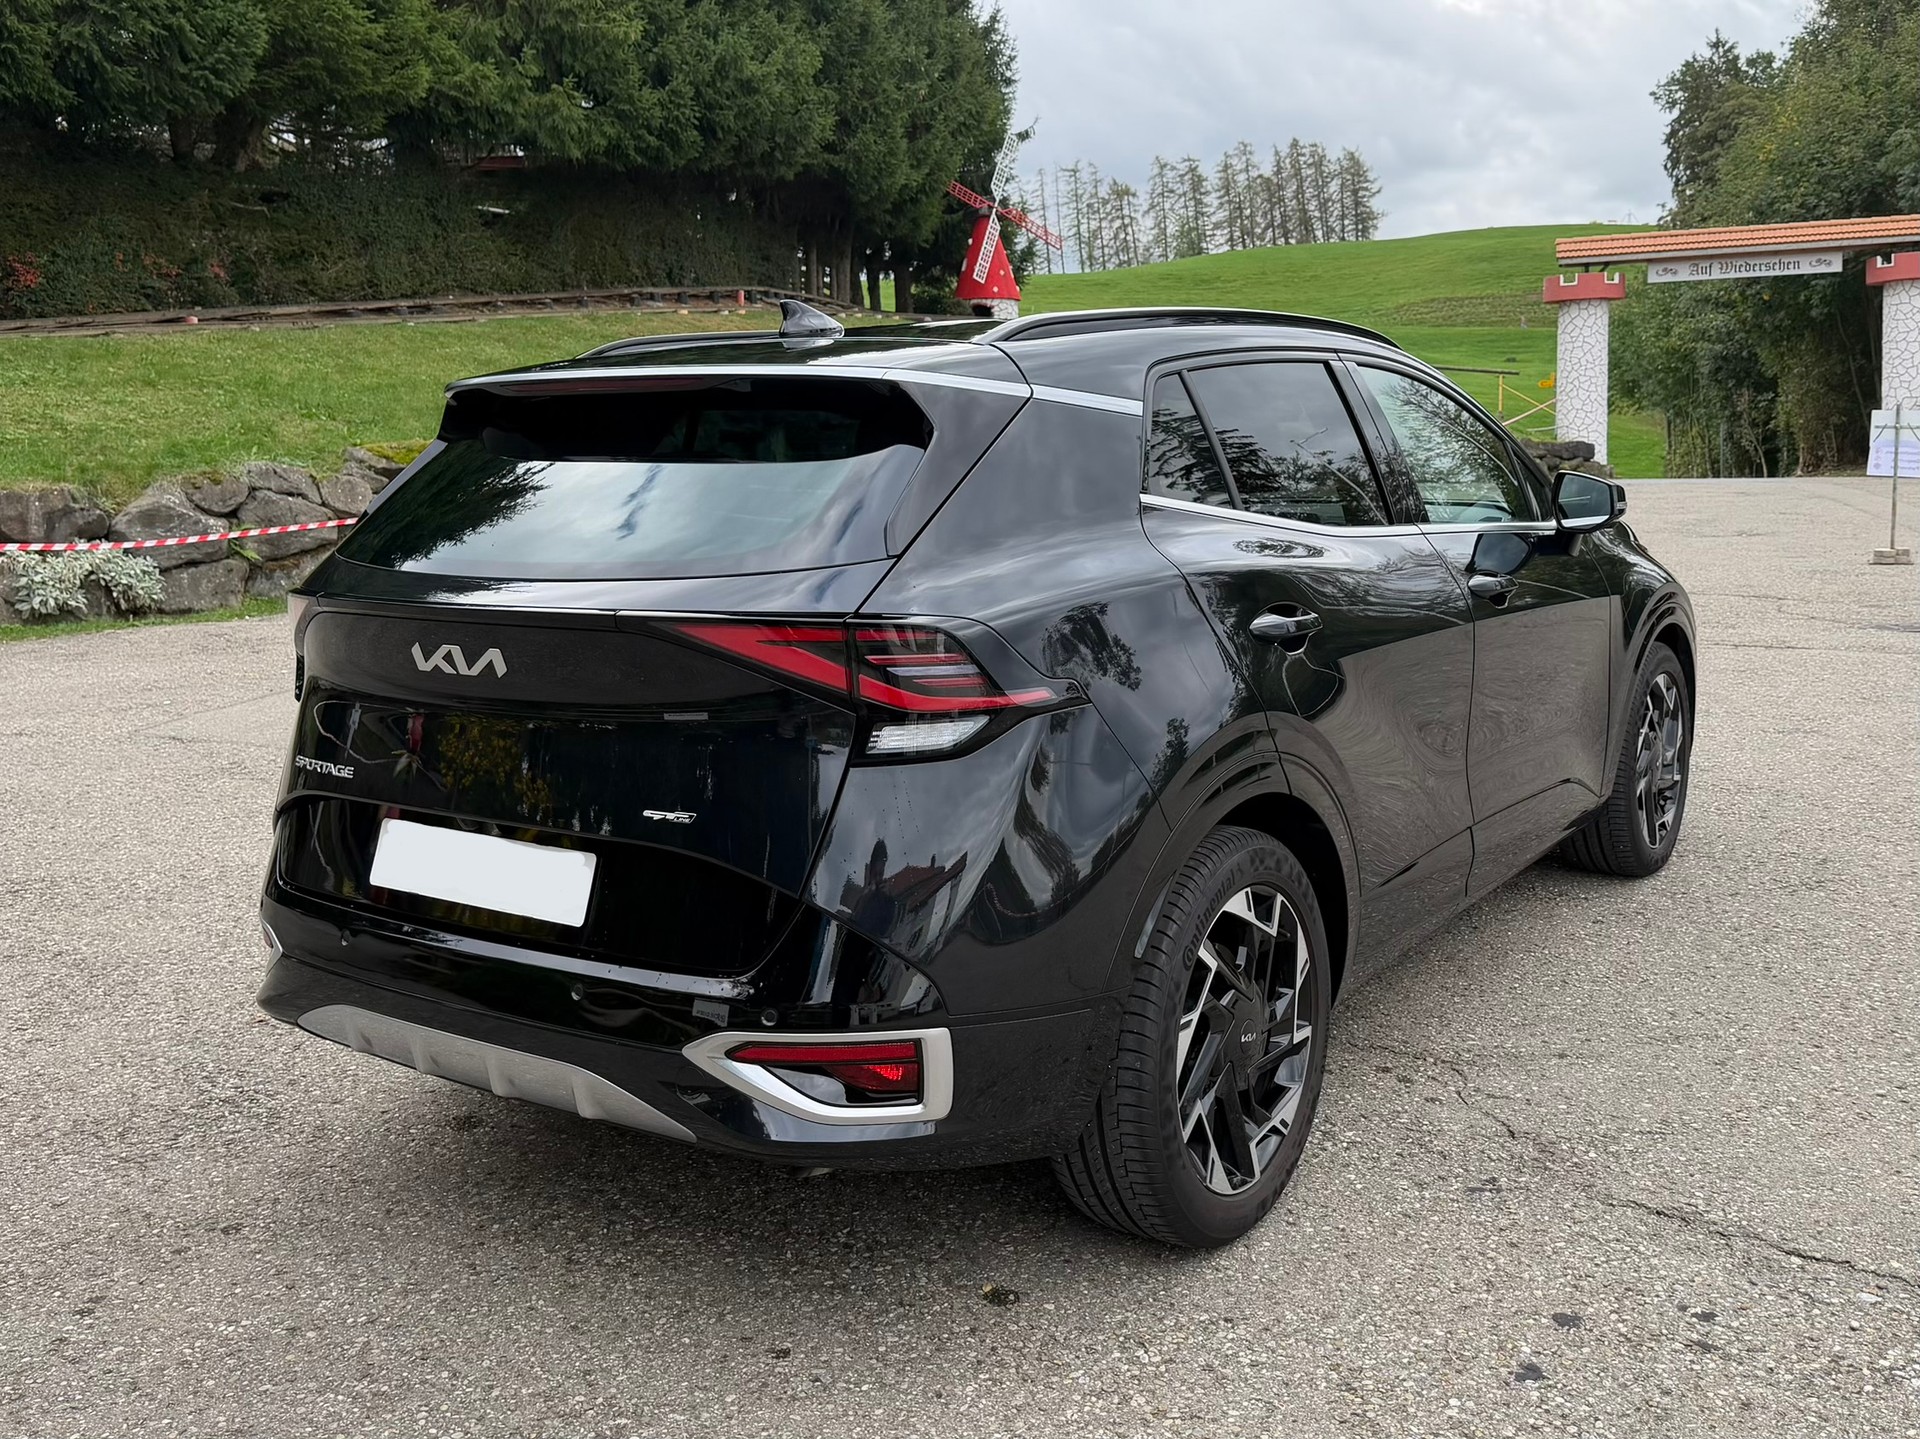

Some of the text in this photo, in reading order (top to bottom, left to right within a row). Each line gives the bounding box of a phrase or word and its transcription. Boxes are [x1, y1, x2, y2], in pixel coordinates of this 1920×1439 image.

[1688, 258, 1801, 277] Auf Wiedersehen
[411, 641, 508, 679] KIA
[295, 755, 355, 779] SPORTAGE
[1183, 868, 1236, 972] Continental
